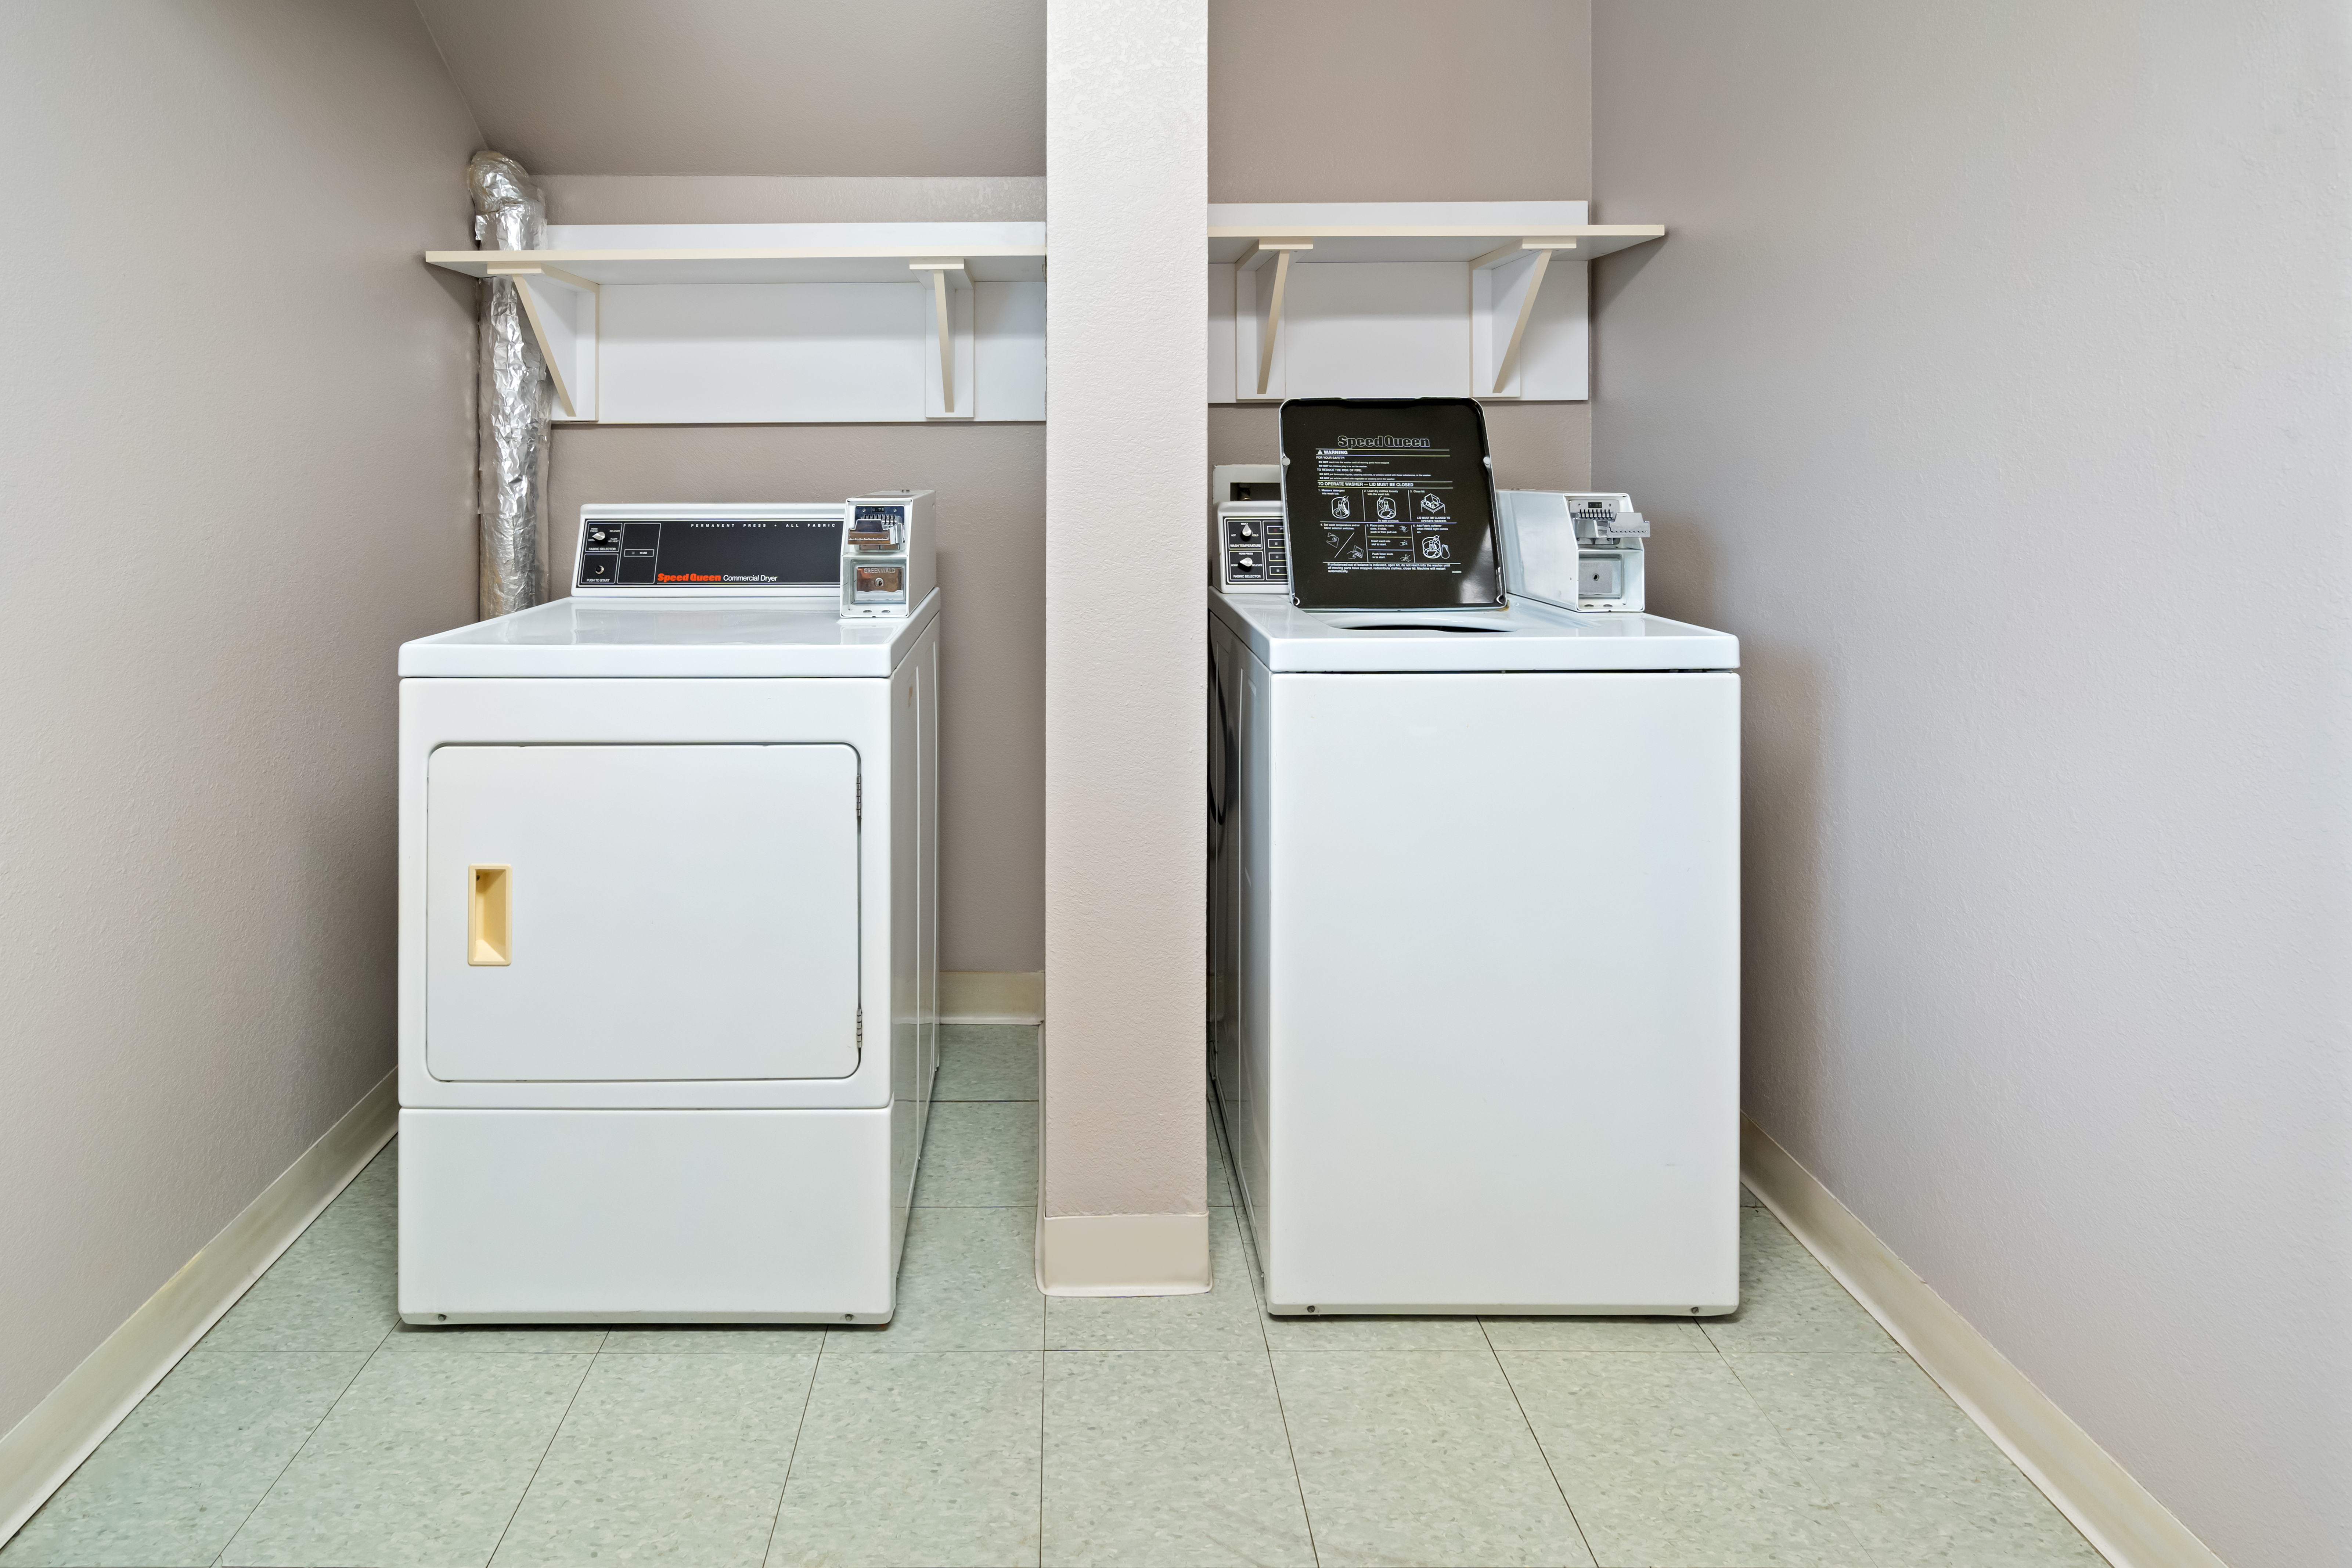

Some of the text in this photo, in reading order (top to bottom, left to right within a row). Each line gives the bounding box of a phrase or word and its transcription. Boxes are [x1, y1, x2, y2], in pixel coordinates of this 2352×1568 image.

[1337, 435, 1430, 449] Speed Queen
[658, 573, 689, 583] Speed
